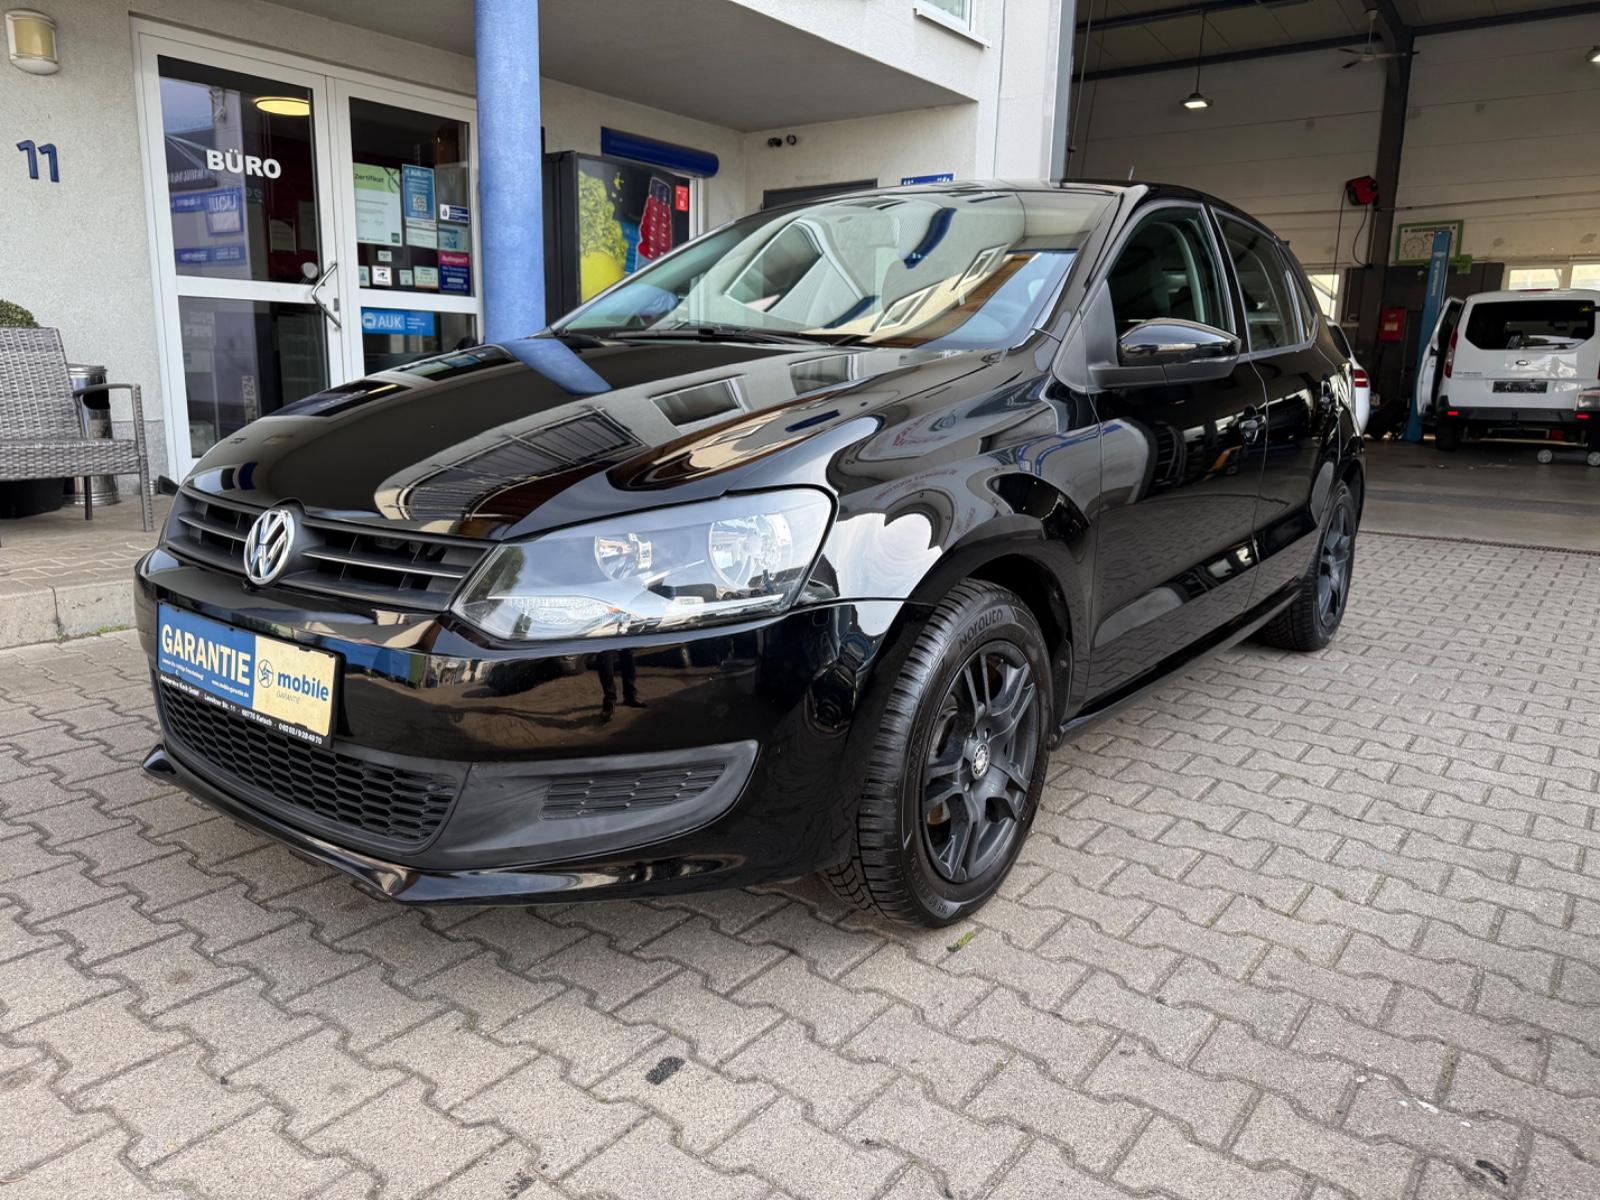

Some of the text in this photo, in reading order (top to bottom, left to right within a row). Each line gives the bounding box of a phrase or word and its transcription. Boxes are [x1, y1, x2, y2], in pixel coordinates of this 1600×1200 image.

[16, 139, 60, 183] 11
[206, 148, 281, 180] BÜRO
[354, 172, 384, 183] Zertifikat
[378, 314, 402, 329] AUK
[161, 623, 251, 686] GARANTIE
[277, 670, 329, 701] mobile
